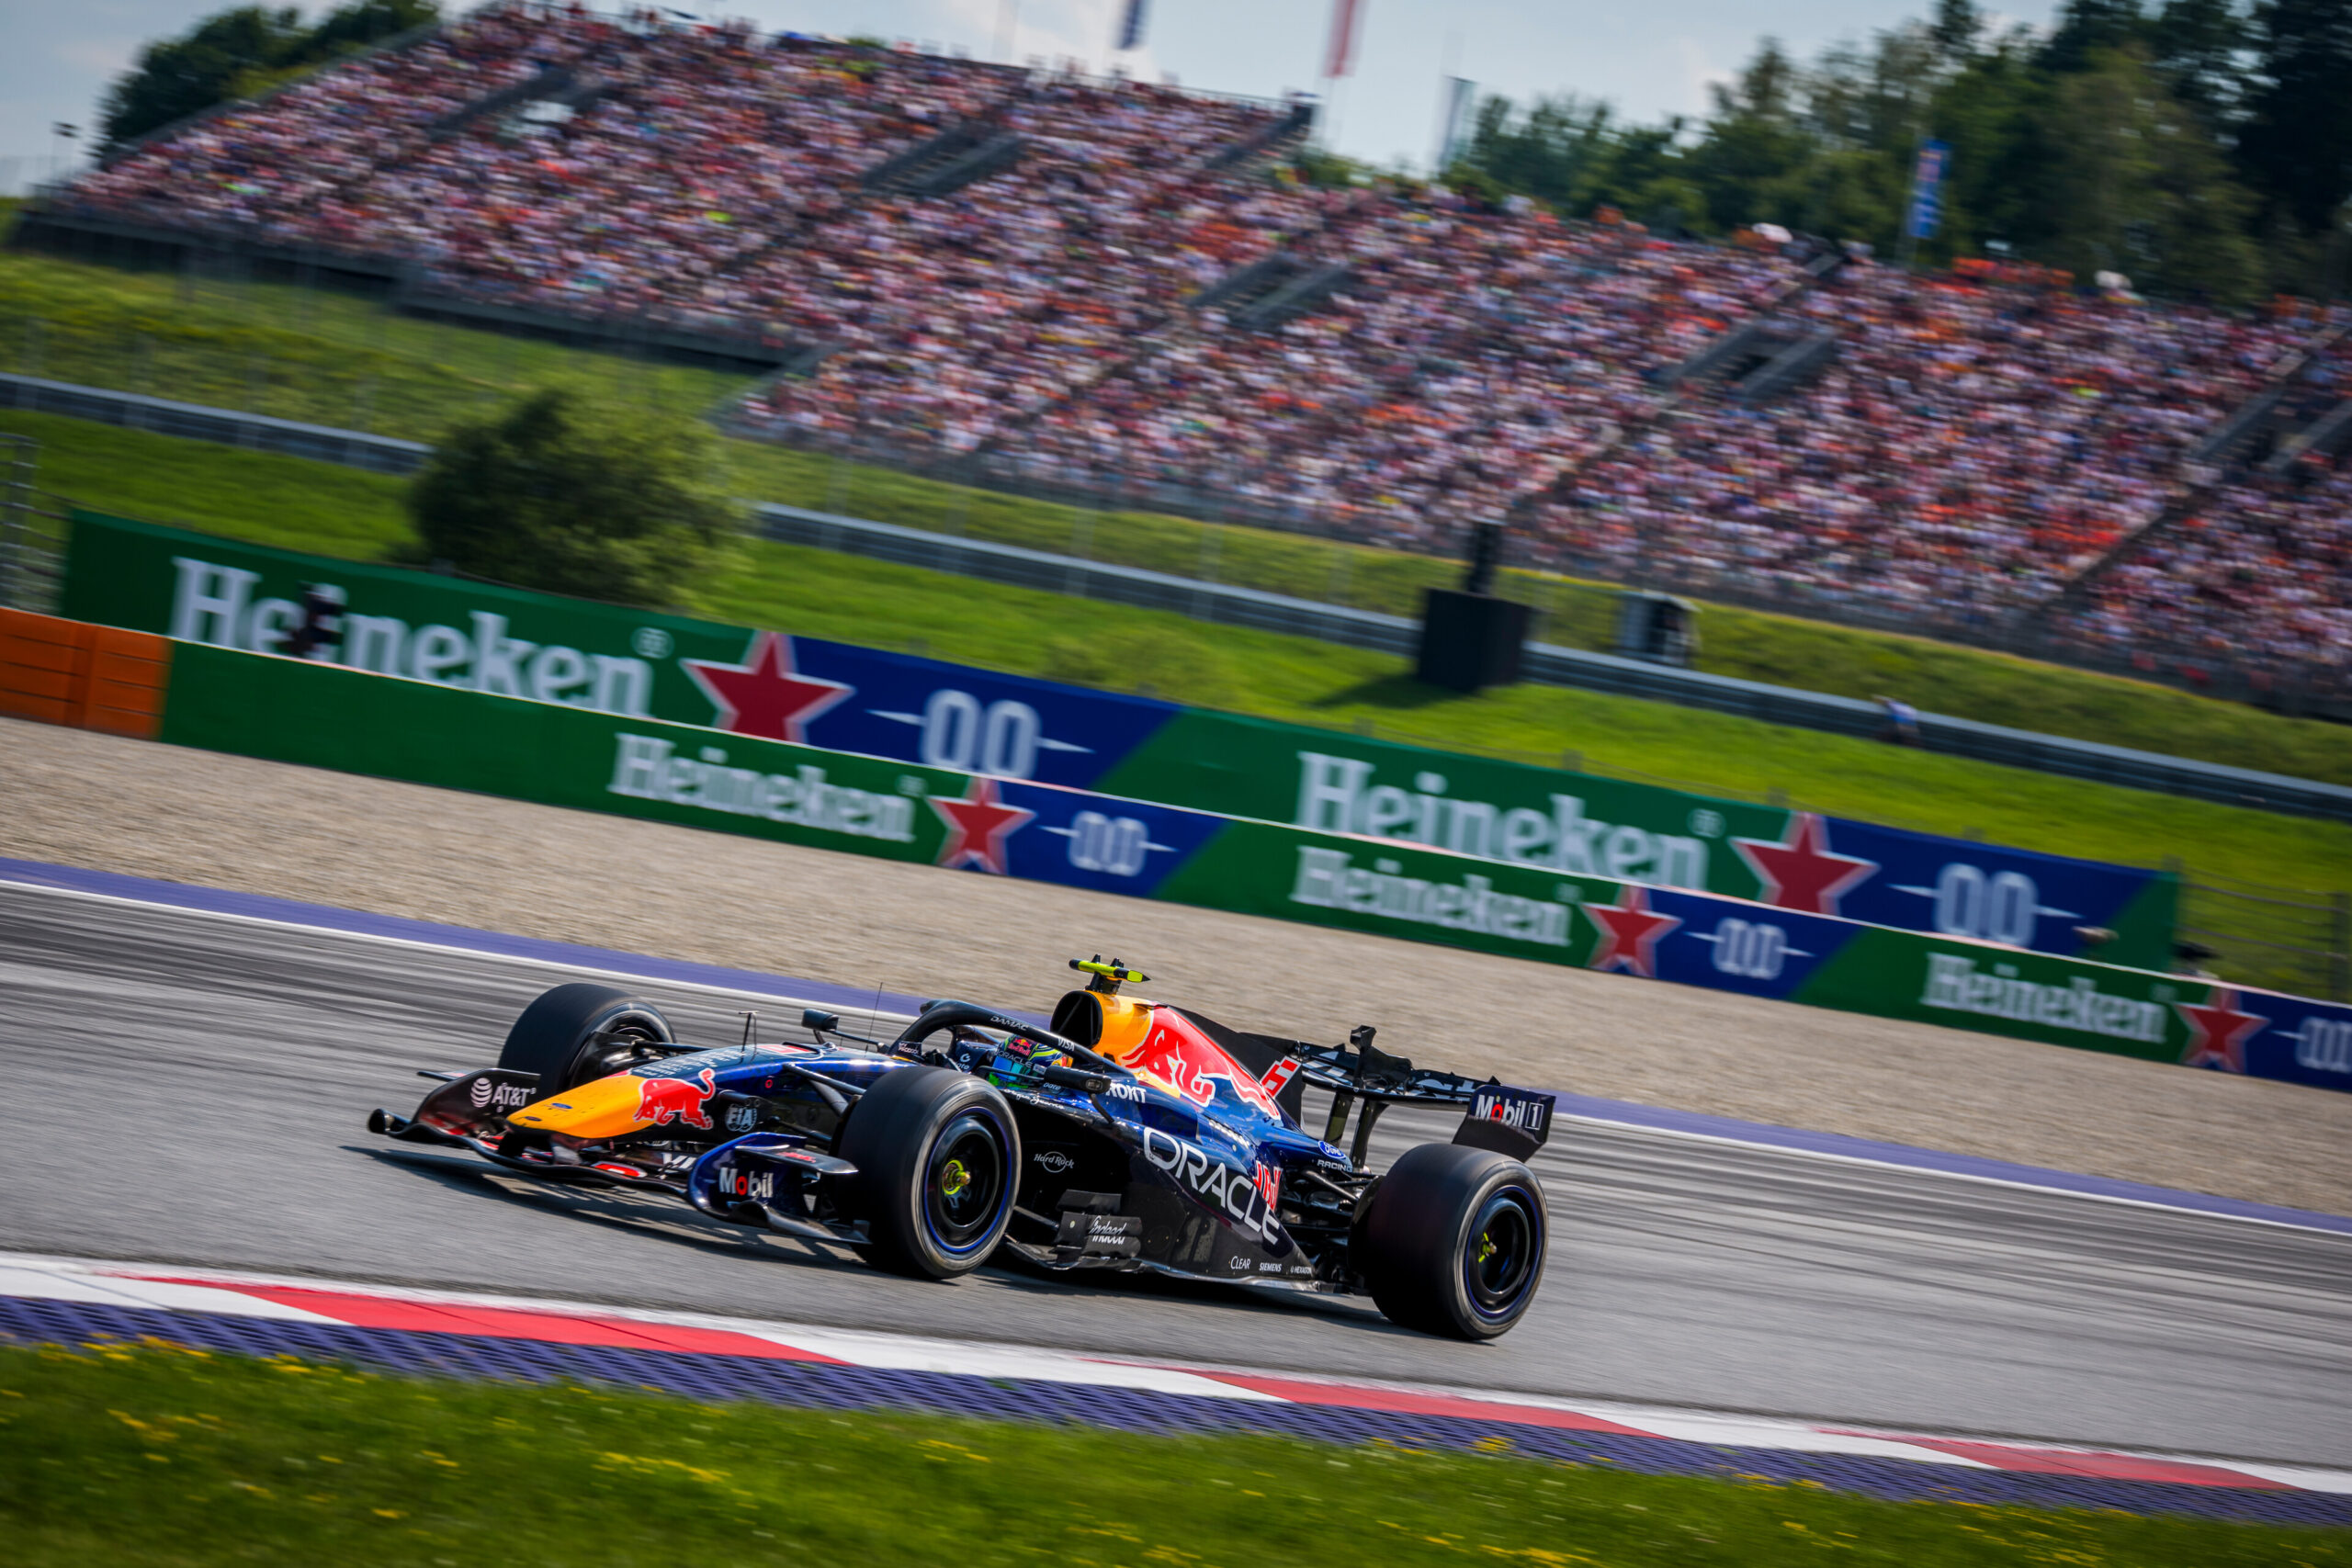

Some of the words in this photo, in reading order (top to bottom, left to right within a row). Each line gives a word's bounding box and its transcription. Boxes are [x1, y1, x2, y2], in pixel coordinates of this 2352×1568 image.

[169, 555, 654, 718] Heneken
[607, 733, 917, 843] Heineken
[1295, 750, 1712, 890] Heineken
[1289, 845, 1571, 947] Heineken
[1920, 951, 2167, 1044] Heineken
[990, 1014, 1029, 1031] DAMAC
[1057, 1037, 1075, 1052] VISA
[998, 1049, 1034, 1067] ORACLE
[491, 1084, 531, 1107] AT&T
[729, 1106, 753, 1128] FIA
[1476, 1094, 1527, 1128] Mobil
[1034, 1153, 1056, 1164] Hard
[1055, 1156, 1075, 1169] Rock
[1317, 1159, 1353, 1173] RACING
[719, 1167, 774, 1198] Mobil
[1143, 1126, 1280, 1245] ORACLE
[1230, 1255, 1251, 1269] CLEAR
[1259, 1262, 1283, 1272] SIEMENS
